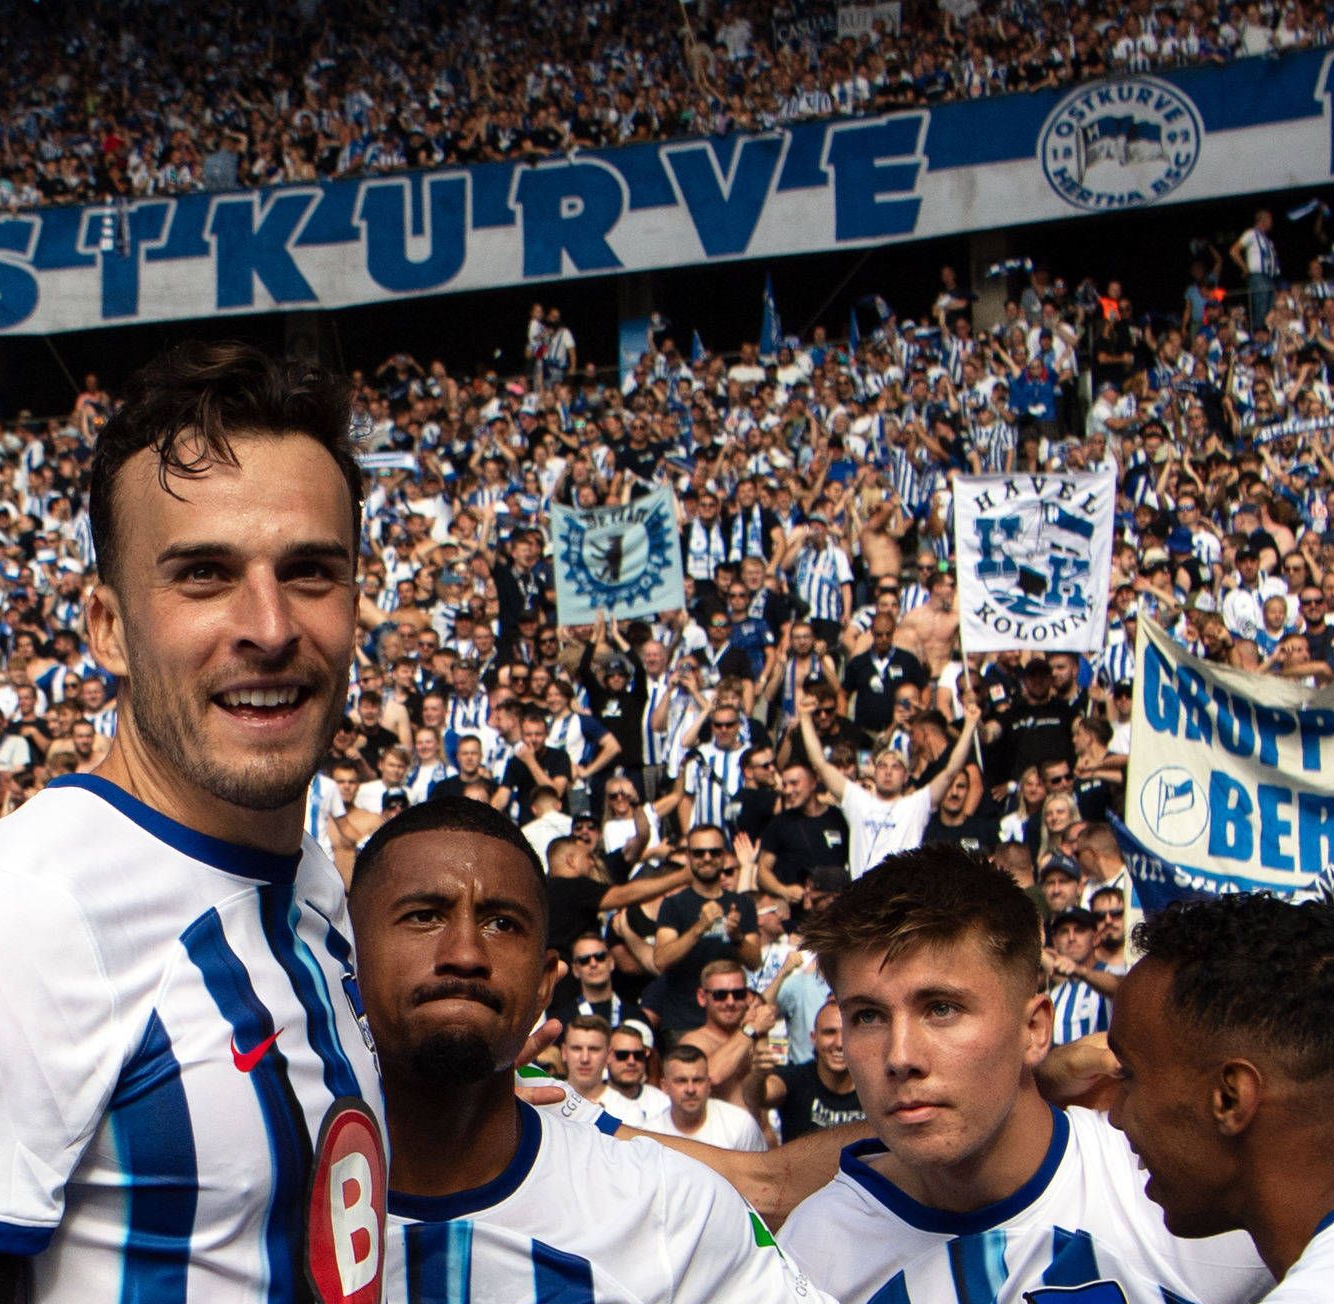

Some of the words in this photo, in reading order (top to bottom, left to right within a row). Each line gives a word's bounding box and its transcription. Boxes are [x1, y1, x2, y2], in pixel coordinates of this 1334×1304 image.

[1054, 85, 1184, 138] OSTKURVE
[1053, 165, 1146, 205] HERTHA
[1150, 151, 1192, 196] BSC
[973, 475, 1098, 516] HAVEL
[330, 1151, 380, 1298] B
